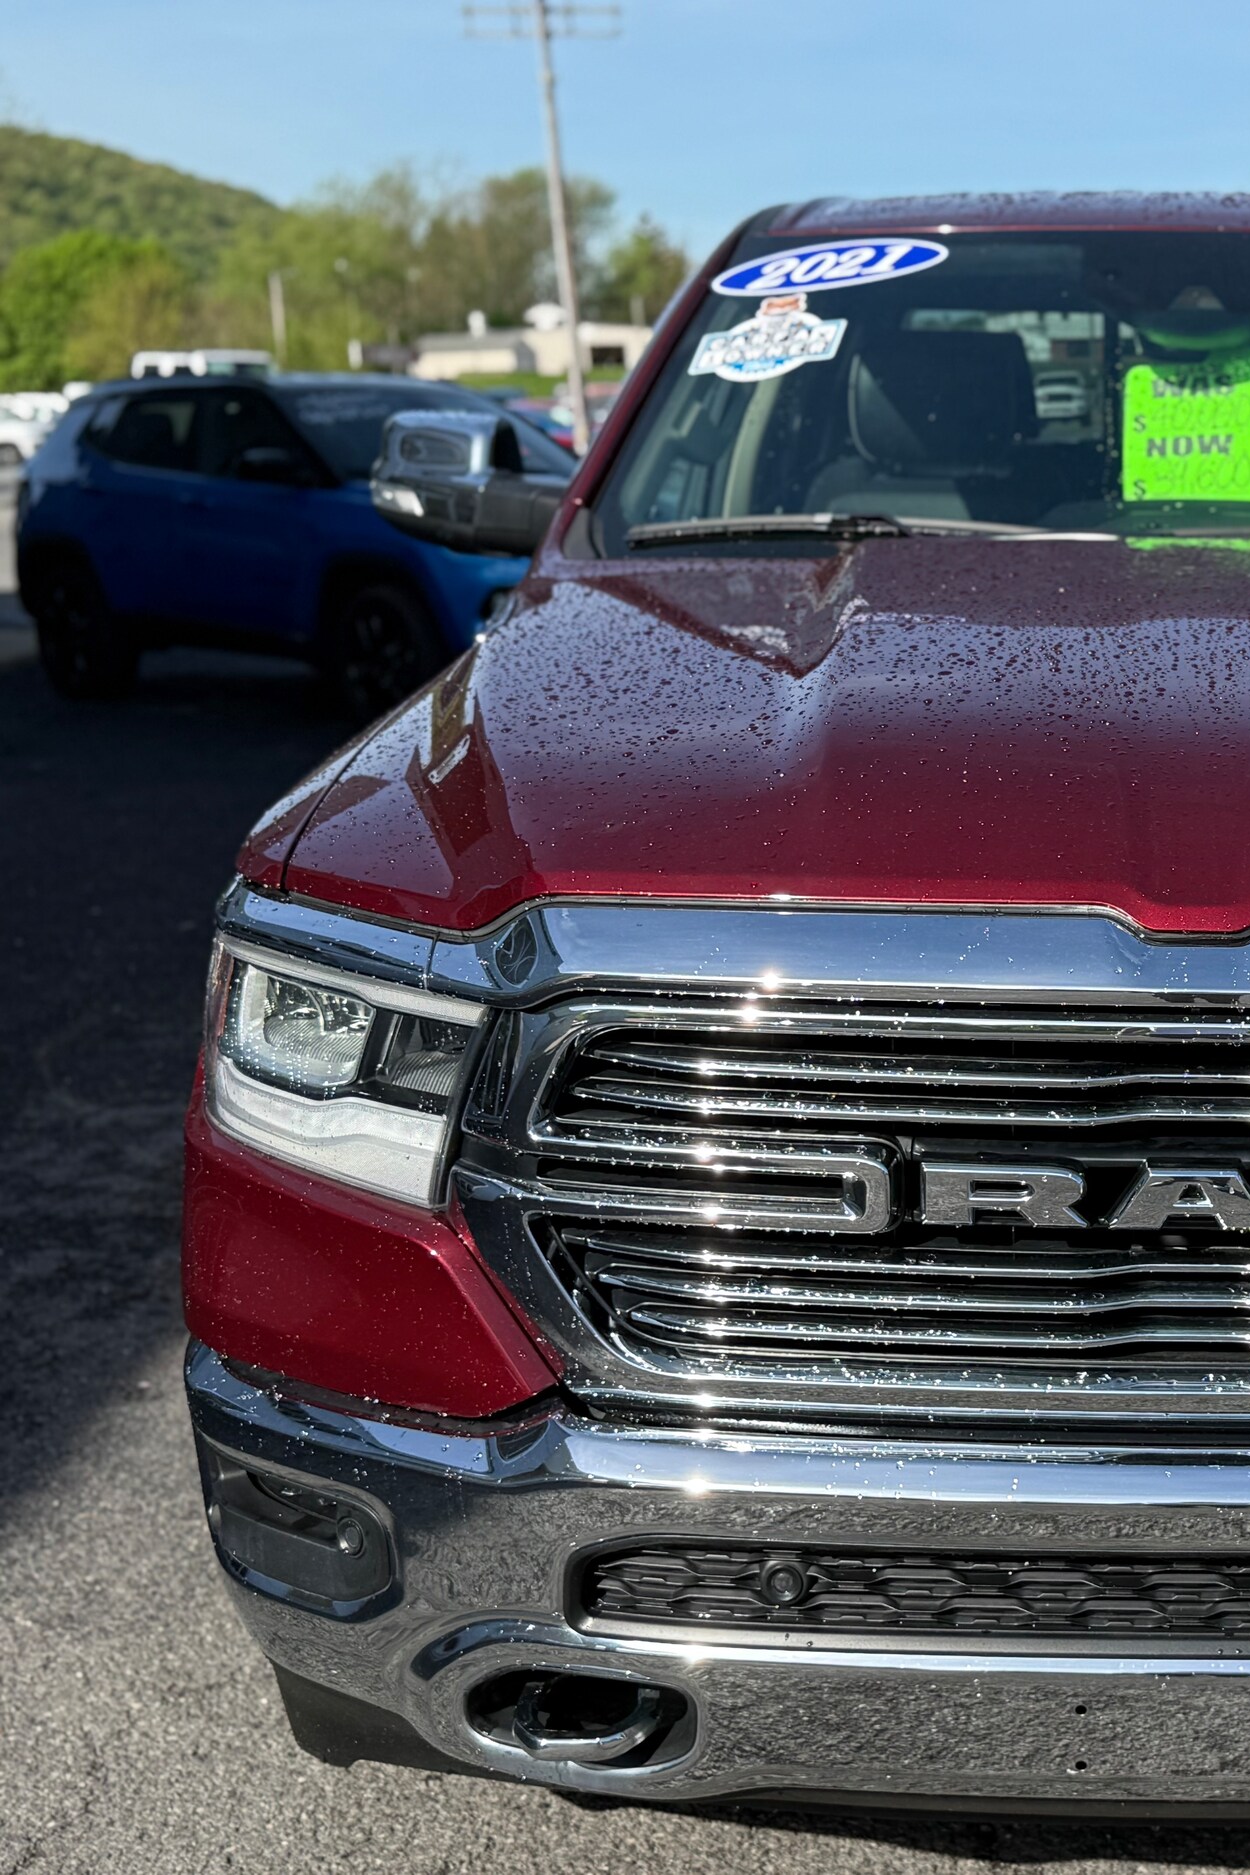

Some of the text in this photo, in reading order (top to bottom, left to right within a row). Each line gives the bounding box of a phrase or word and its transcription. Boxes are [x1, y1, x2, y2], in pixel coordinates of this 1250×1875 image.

[745, 243, 914, 290] 2021
[1153, 373, 1234, 398] WAS
[1146, 434, 1234, 458] NOW
